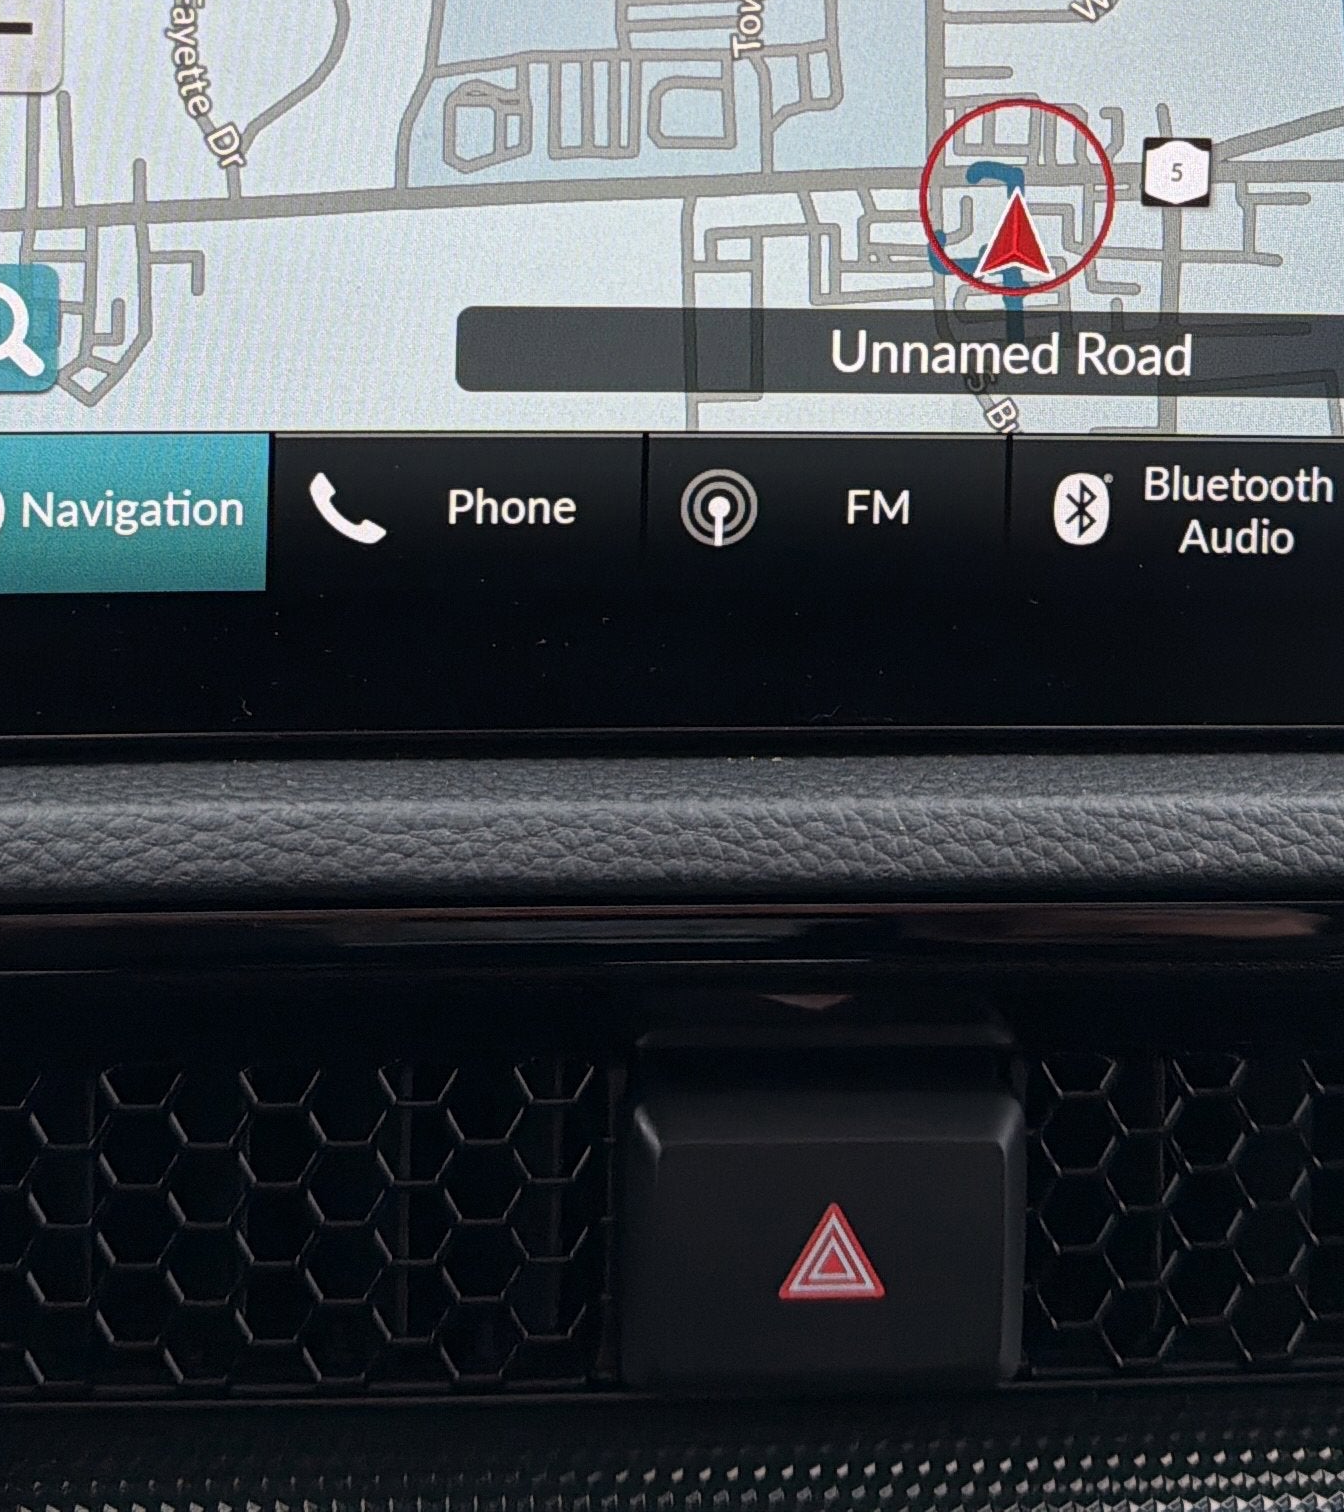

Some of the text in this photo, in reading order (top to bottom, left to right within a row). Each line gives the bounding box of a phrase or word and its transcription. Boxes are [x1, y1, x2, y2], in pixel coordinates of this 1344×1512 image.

[207, 124, 247, 167] Dr
[1170, 162, 1184, 183] 5
[831, 329, 1192, 378] Unnamed Road
[1144, 464, 1335, 504] Bluetooth
[22, 488, 244, 534] Navigation
[448, 488, 577, 526] Phone
[847, 490, 910, 525] FM
[1178, 518, 1295, 556] Audio
